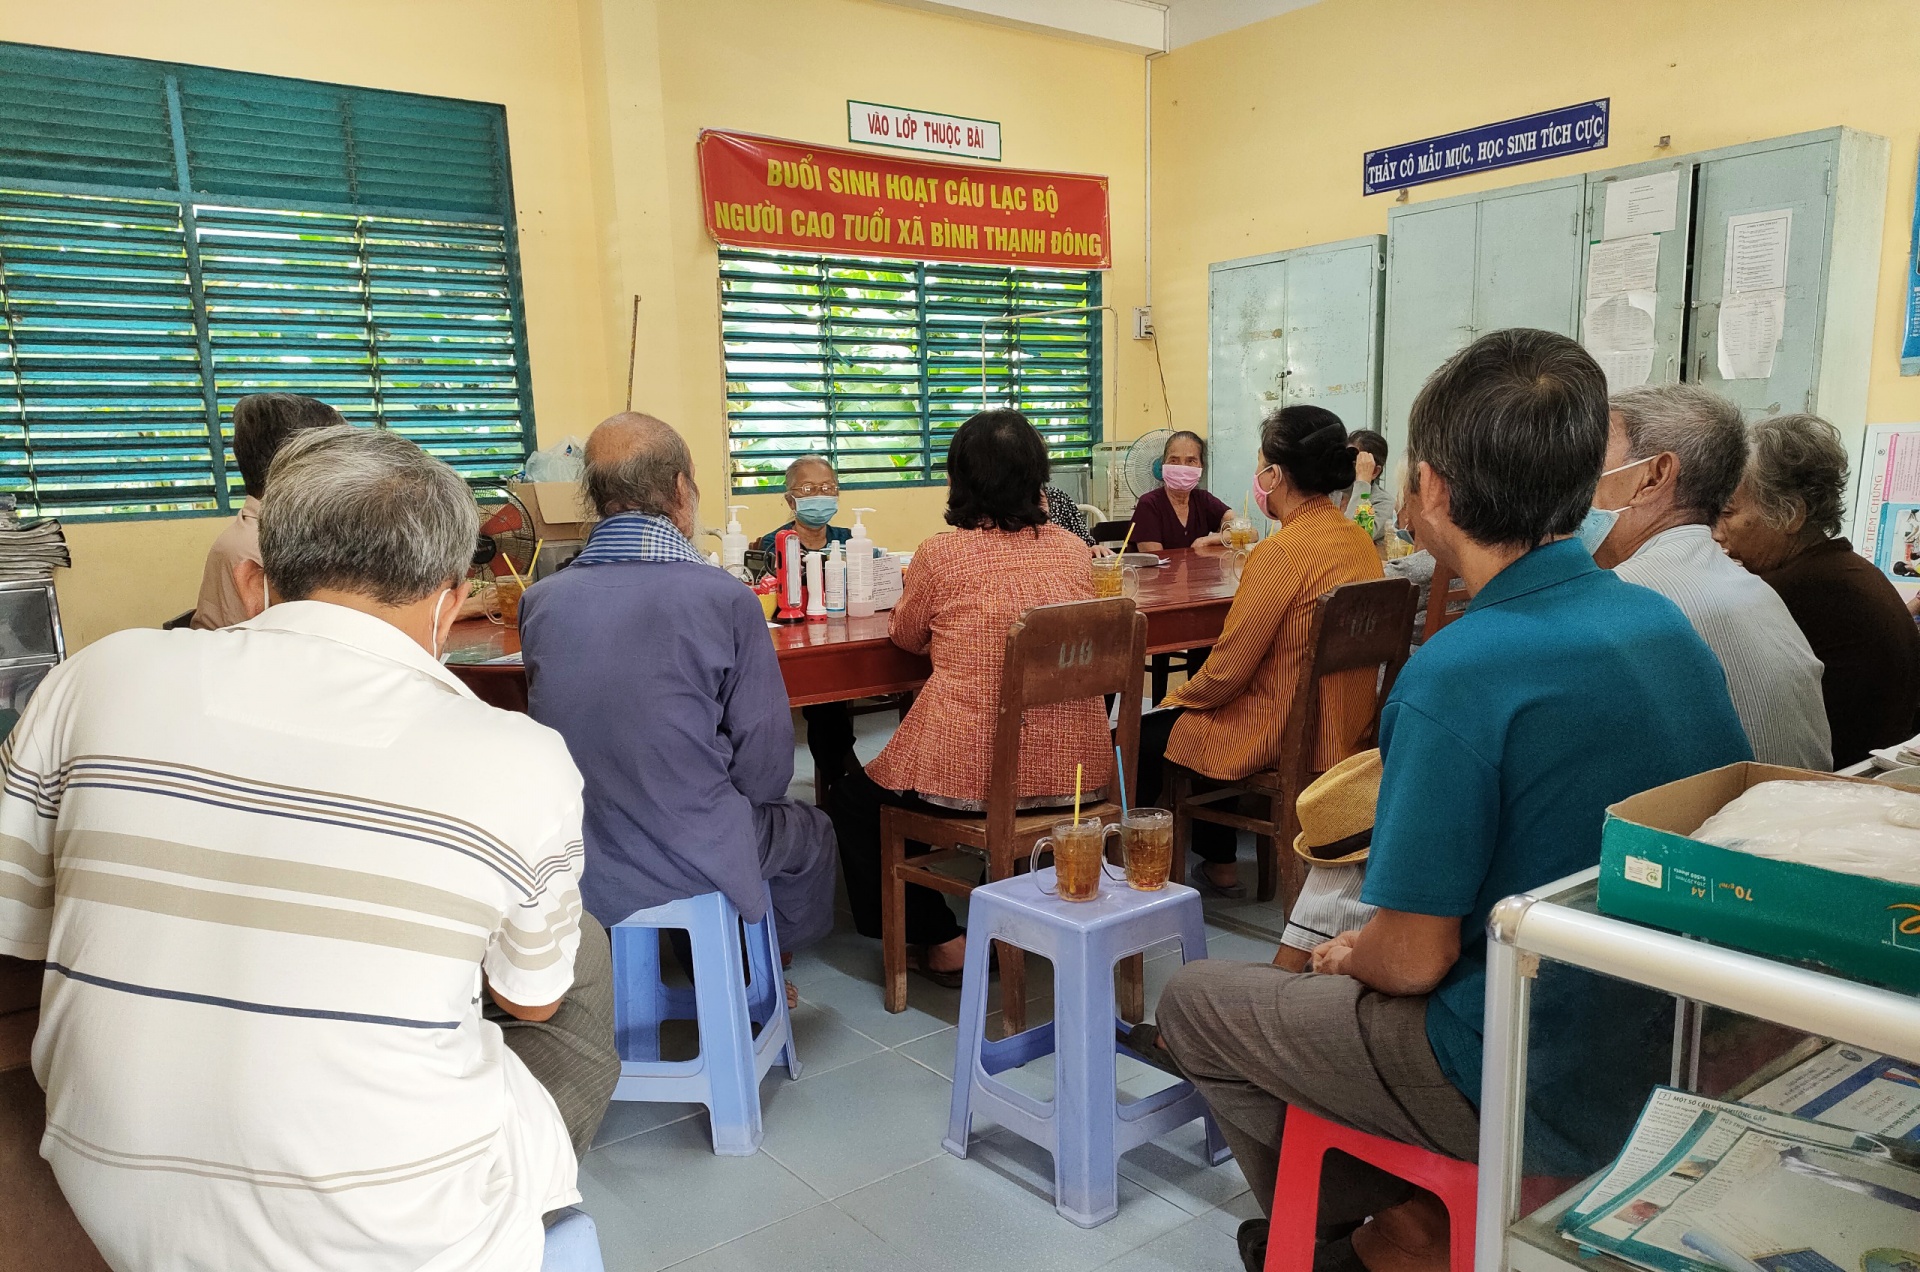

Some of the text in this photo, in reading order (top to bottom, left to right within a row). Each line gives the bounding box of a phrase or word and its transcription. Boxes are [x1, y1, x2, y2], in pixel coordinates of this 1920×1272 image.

[867, 111, 984, 149] VÀO LỚP THUỘC BÀI
[1368, 114, 1603, 184] THẦY CÔ MẪU MỰC, HỌC SINH TÍCH CỰC
[767, 153, 1059, 219] BUỔI SINH HOẠT CÂU LẠC BỘ
[714, 199, 1102, 257] NGƯỜI CAO TUỔI XÃ BÌNH THẠNH ĐÔNG
[1690, 886, 1707, 898] A4
